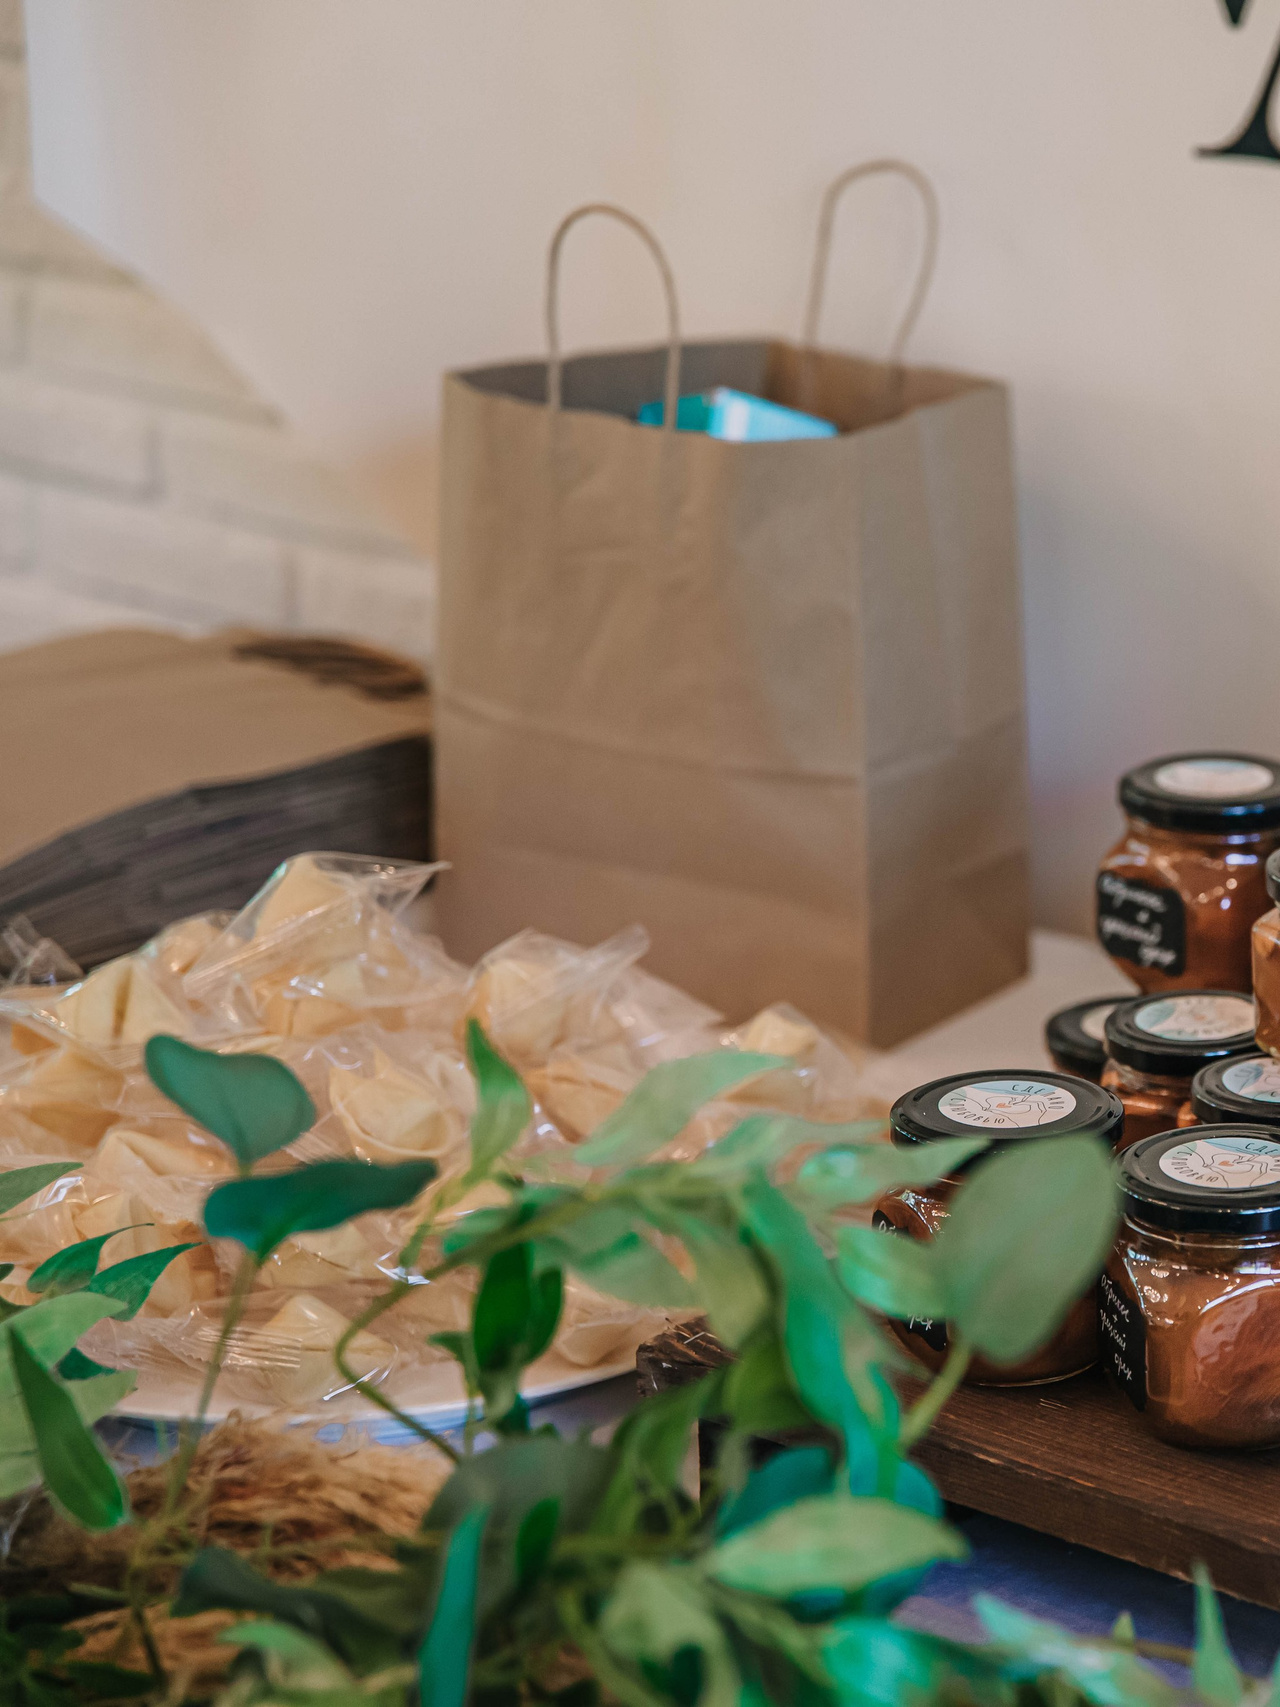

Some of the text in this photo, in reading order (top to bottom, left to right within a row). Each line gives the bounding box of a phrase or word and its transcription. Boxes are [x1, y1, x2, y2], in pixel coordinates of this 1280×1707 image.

[1011, 1084, 1065, 1110] СДЕЛАНО
[948, 1102, 1005, 1124] ЛЮБОВЬЮ
[1170, 1156, 1219, 1183] ЛЮБОВЬЮ
